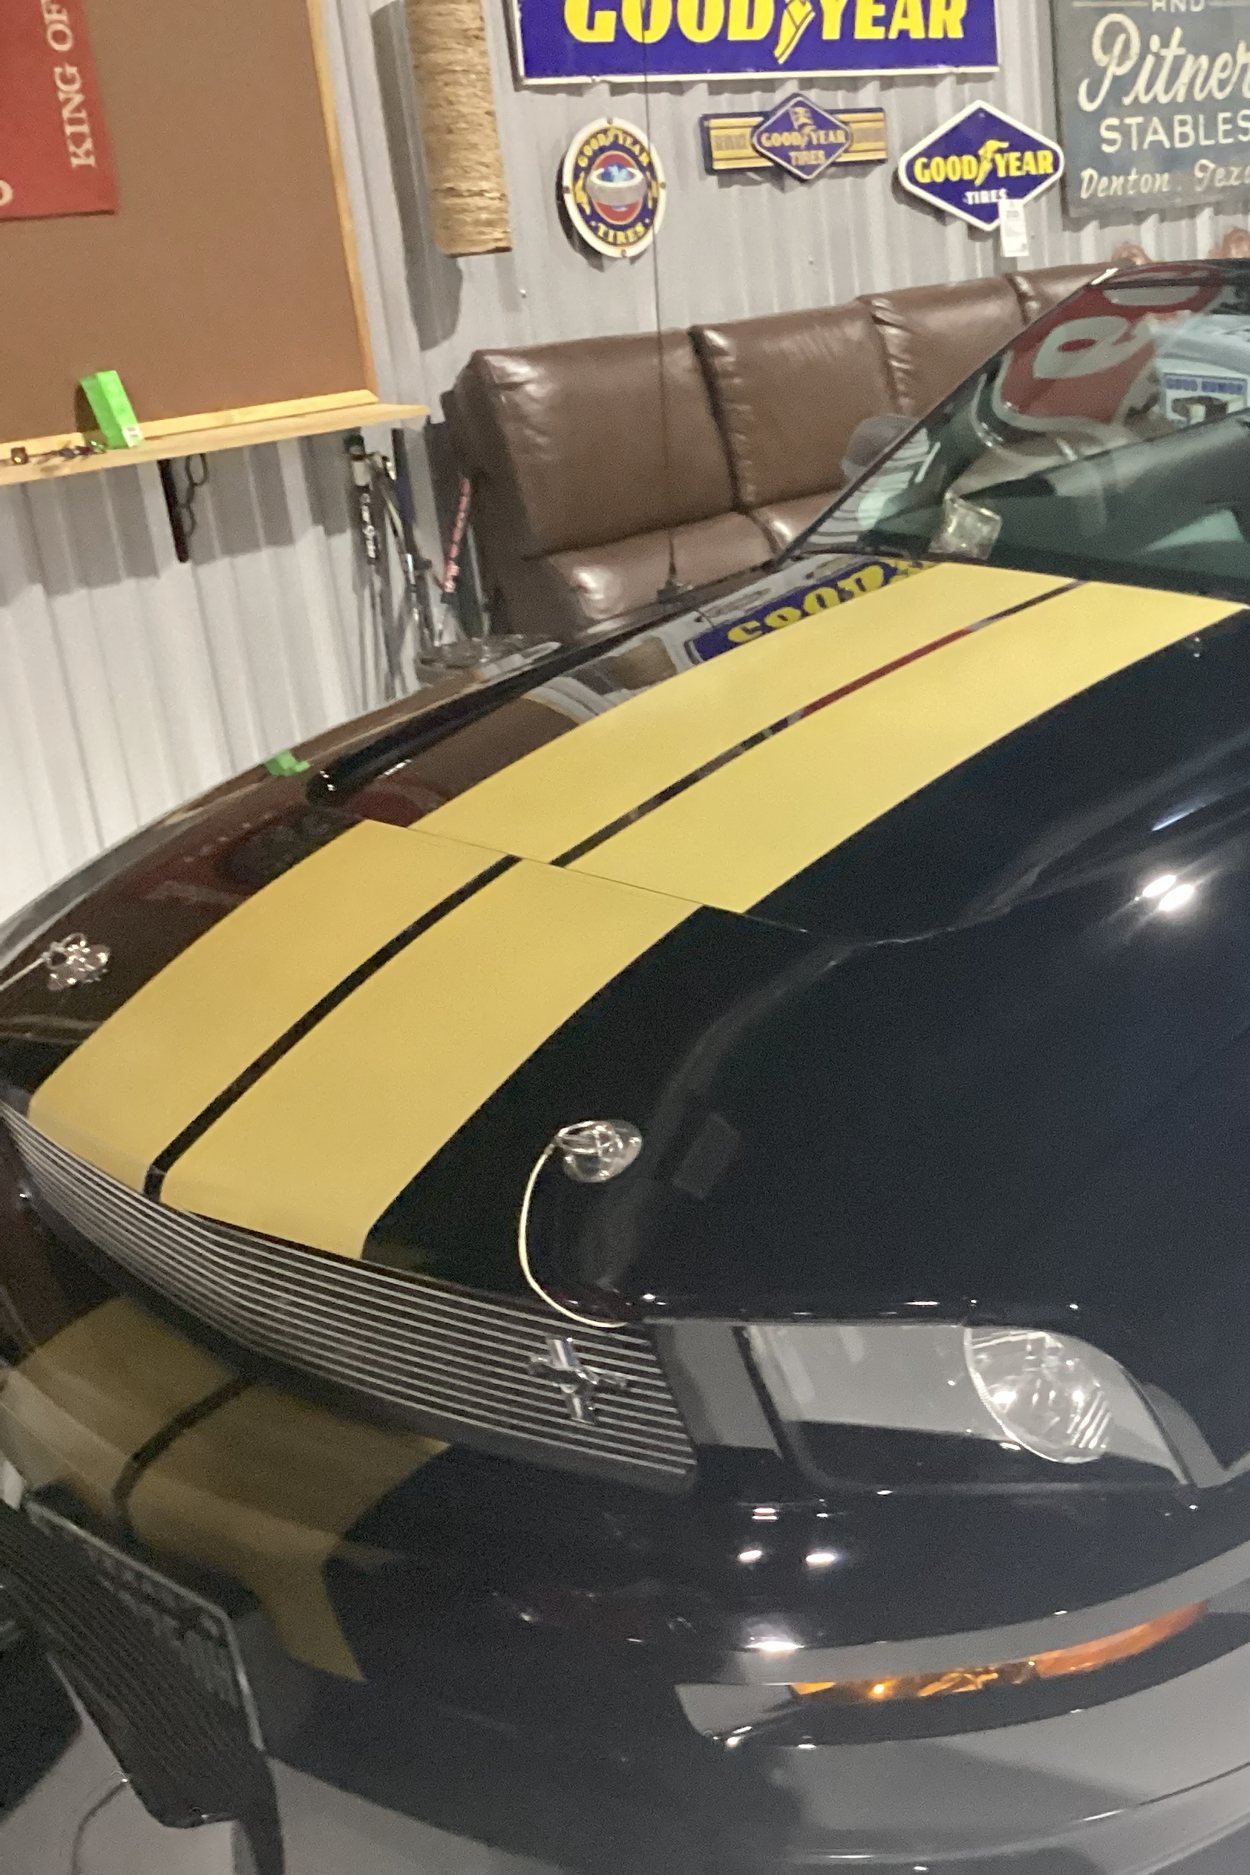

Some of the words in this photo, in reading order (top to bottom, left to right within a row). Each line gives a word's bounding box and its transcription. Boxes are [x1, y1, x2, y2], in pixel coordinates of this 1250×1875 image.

[40, 0, 73, 52] OF
[54, 62, 97, 168] KING
[963, 189, 1008, 206] TIRES
[598, 222, 645, 244] TIRES
